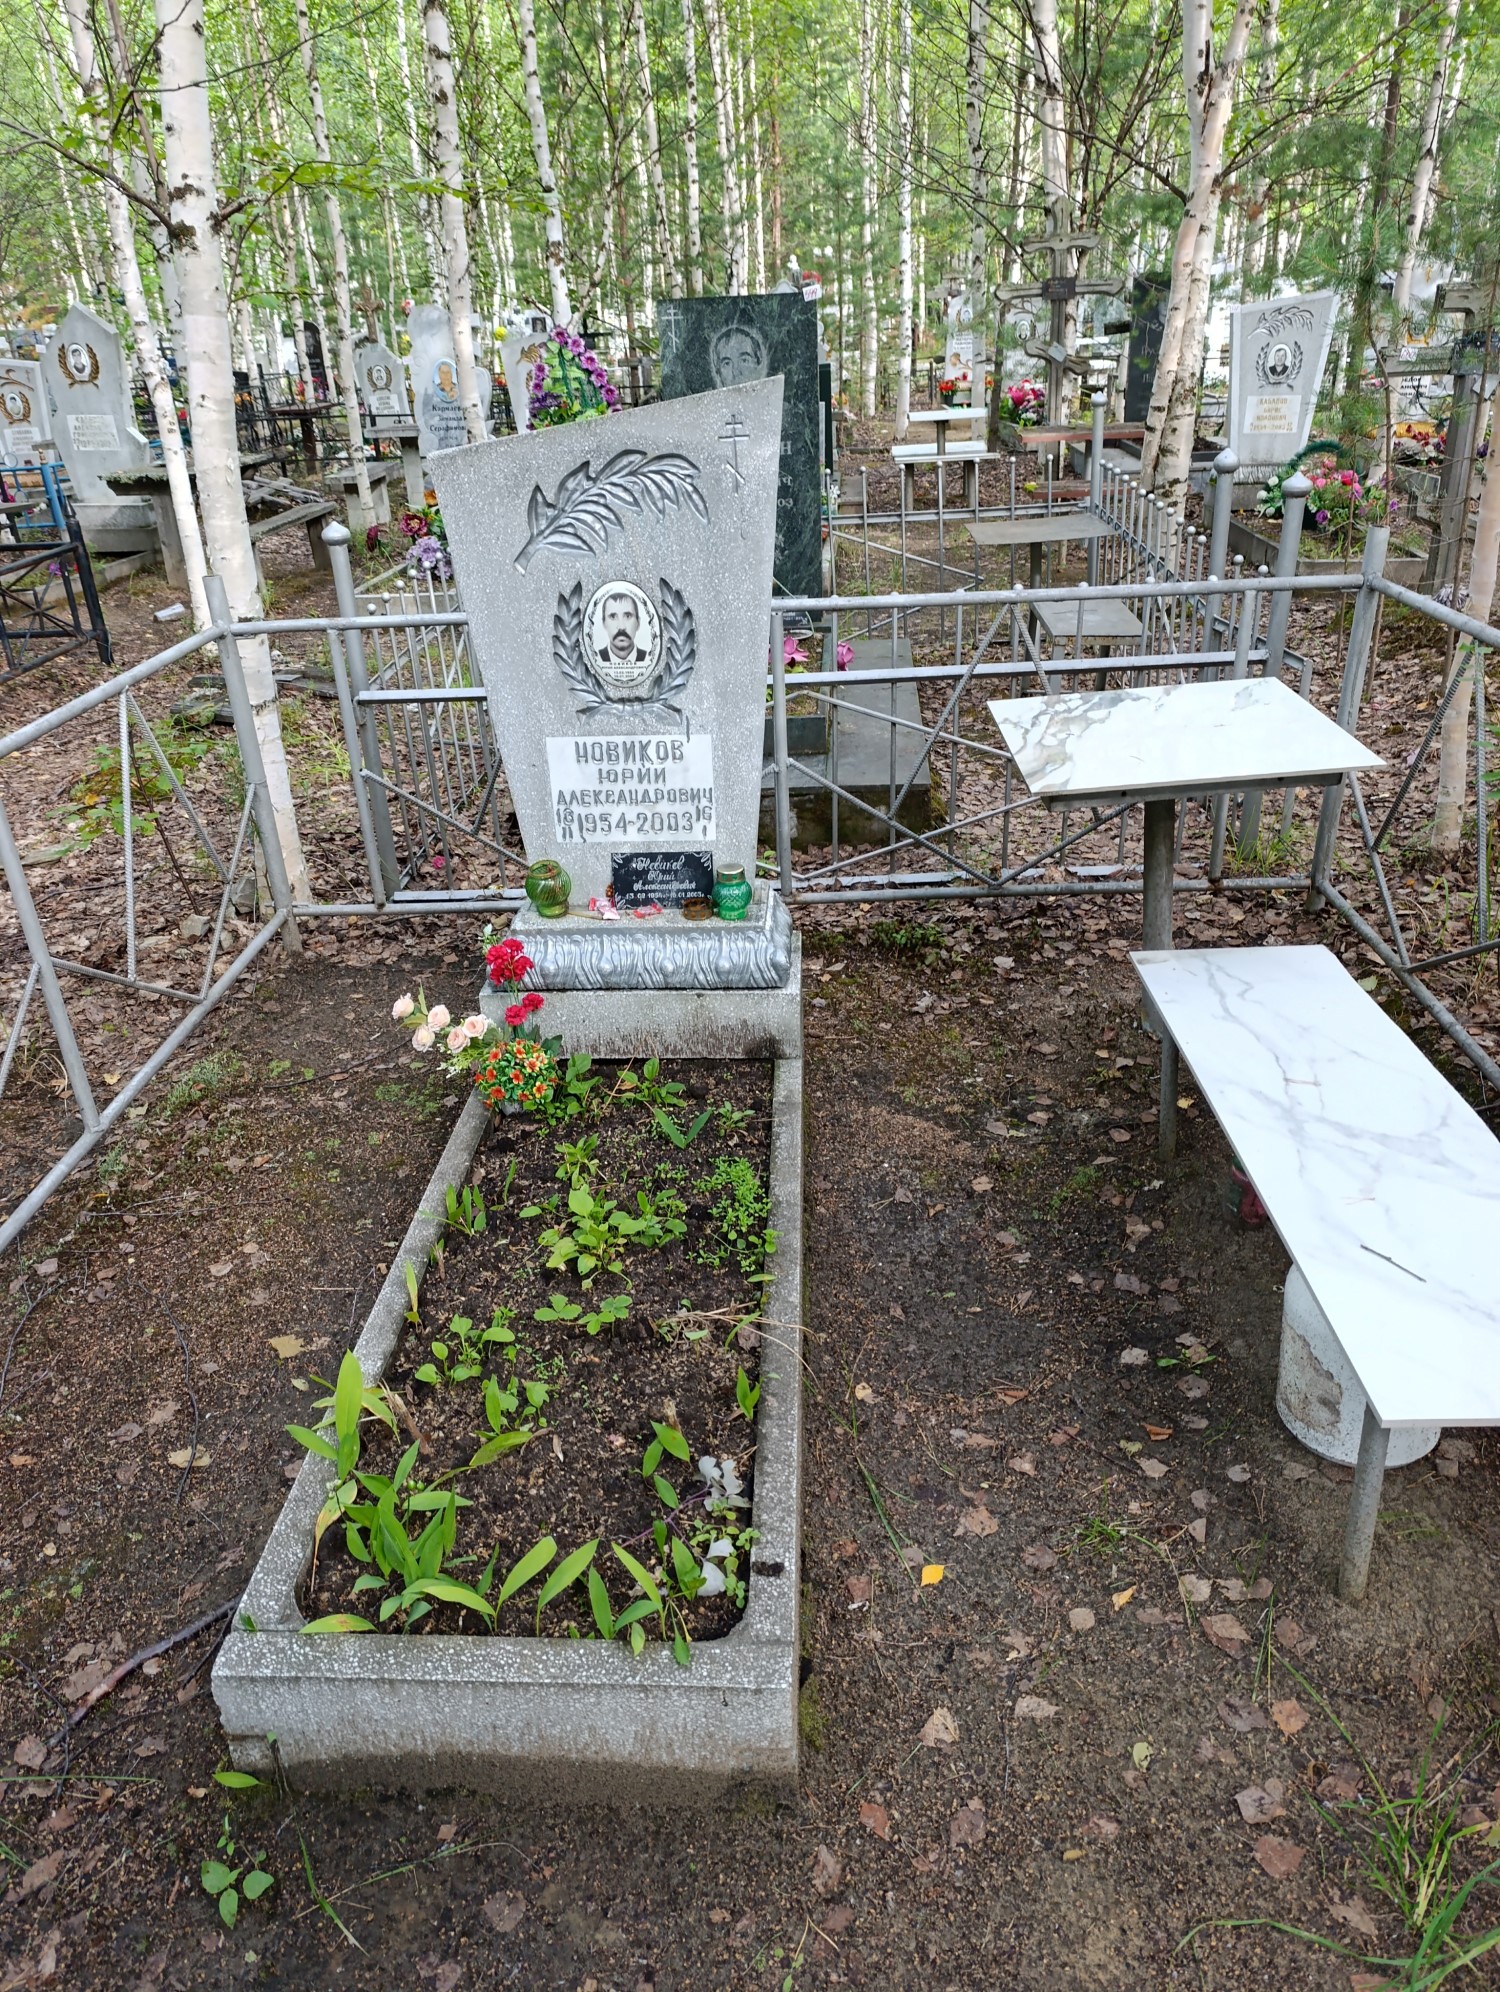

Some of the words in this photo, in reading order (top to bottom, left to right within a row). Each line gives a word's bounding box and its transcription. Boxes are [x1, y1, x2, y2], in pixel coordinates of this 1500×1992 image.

[574, 740, 684, 765] НОВИКОВ
[557, 787, 713, 806] АЛЕКСАНДРОВИЧ
[577, 811, 694, 836] 1954-2003
